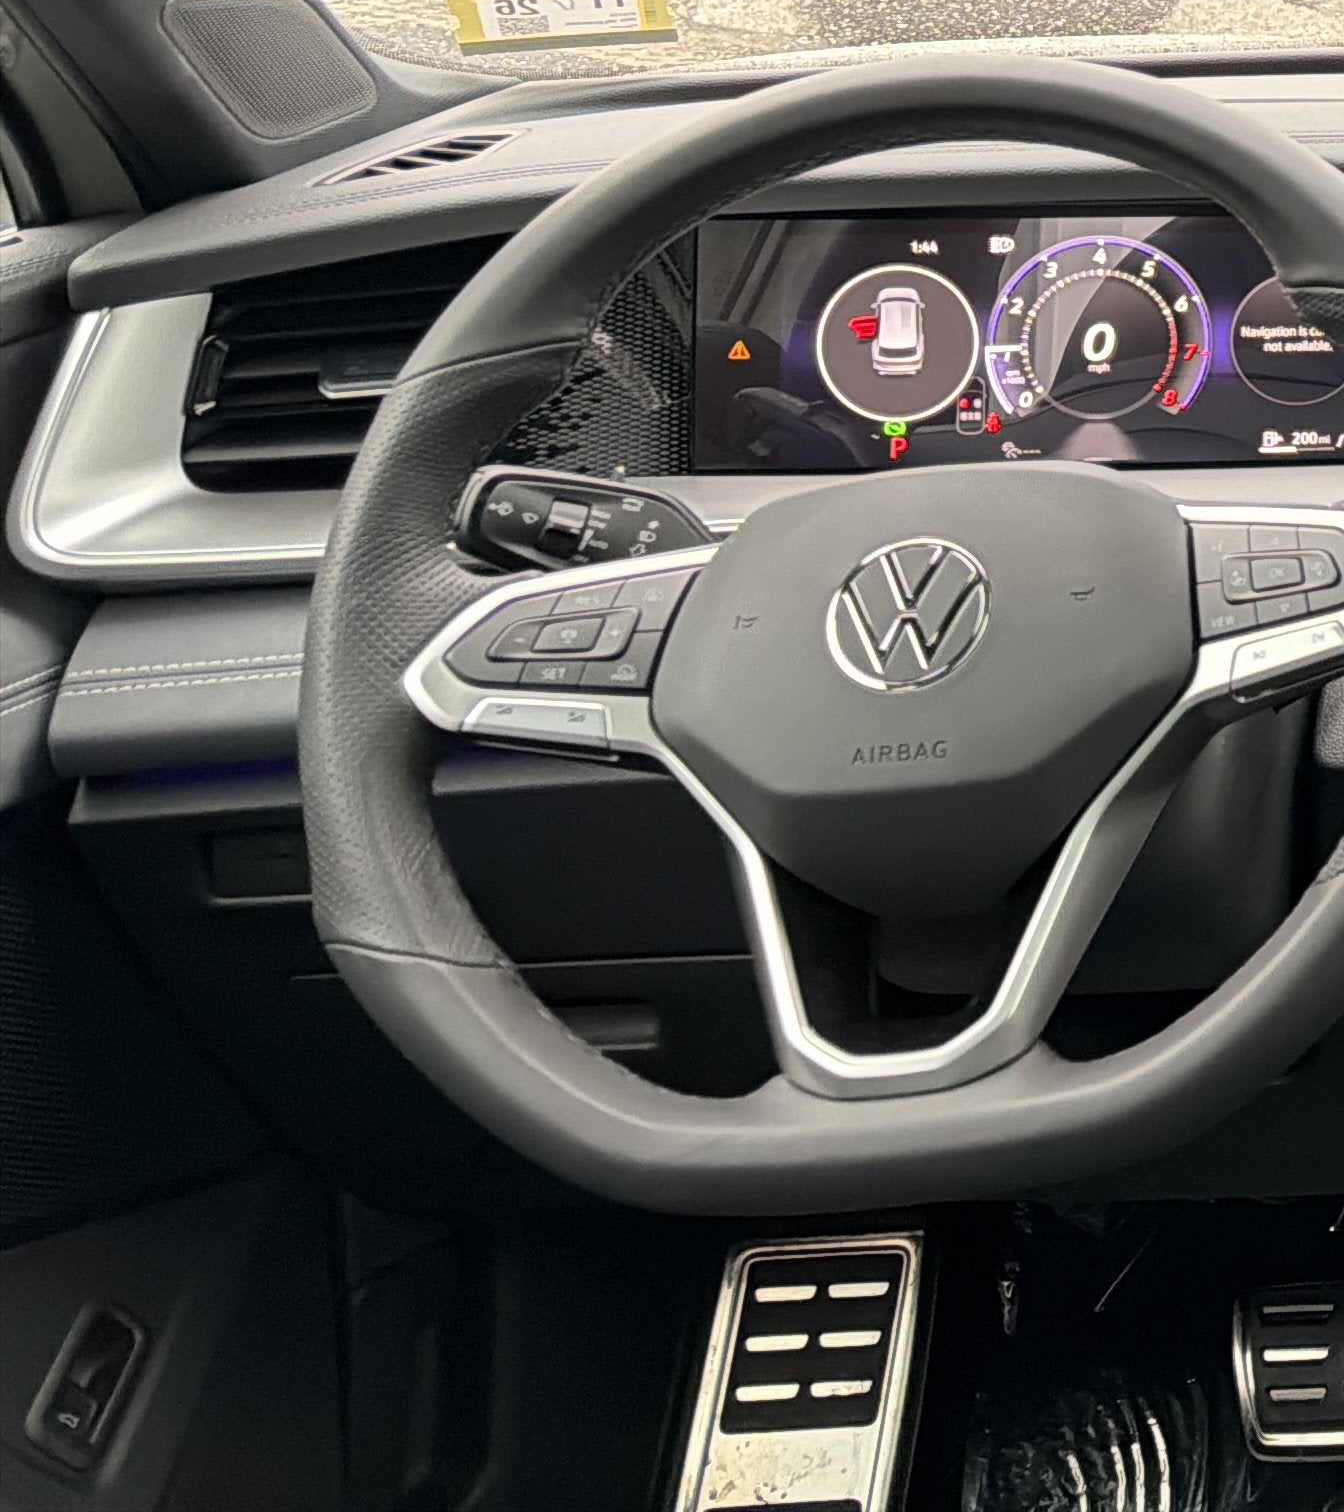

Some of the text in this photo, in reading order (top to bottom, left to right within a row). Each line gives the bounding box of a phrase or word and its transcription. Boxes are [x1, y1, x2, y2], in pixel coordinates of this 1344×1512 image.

[910, 240, 940, 256] 1:44
[1092, 248, 1107, 264] 4
[1043, 261, 1059, 279] 3
[1141, 260, 1157, 278] 5
[1008, 297, 1024, 314] 2
[1174, 294, 1189, 312] 6
[1240, 325, 1297, 340] Navigation
[1298, 326, 1308, 337] is
[1082, 323, 1117, 362] 0
[1262, 340, 1334, 353] not available.
[1183, 343, 1198, 361] 7
[1087, 364, 1111, 374] mph
[1018, 391, 1033, 407] 0
[1162, 389, 1178, 407] 8
[1291, 431, 1331, 445] 200 mi
[889, 437, 909, 461] P
[851, 740, 948, 766] AIRBAG
